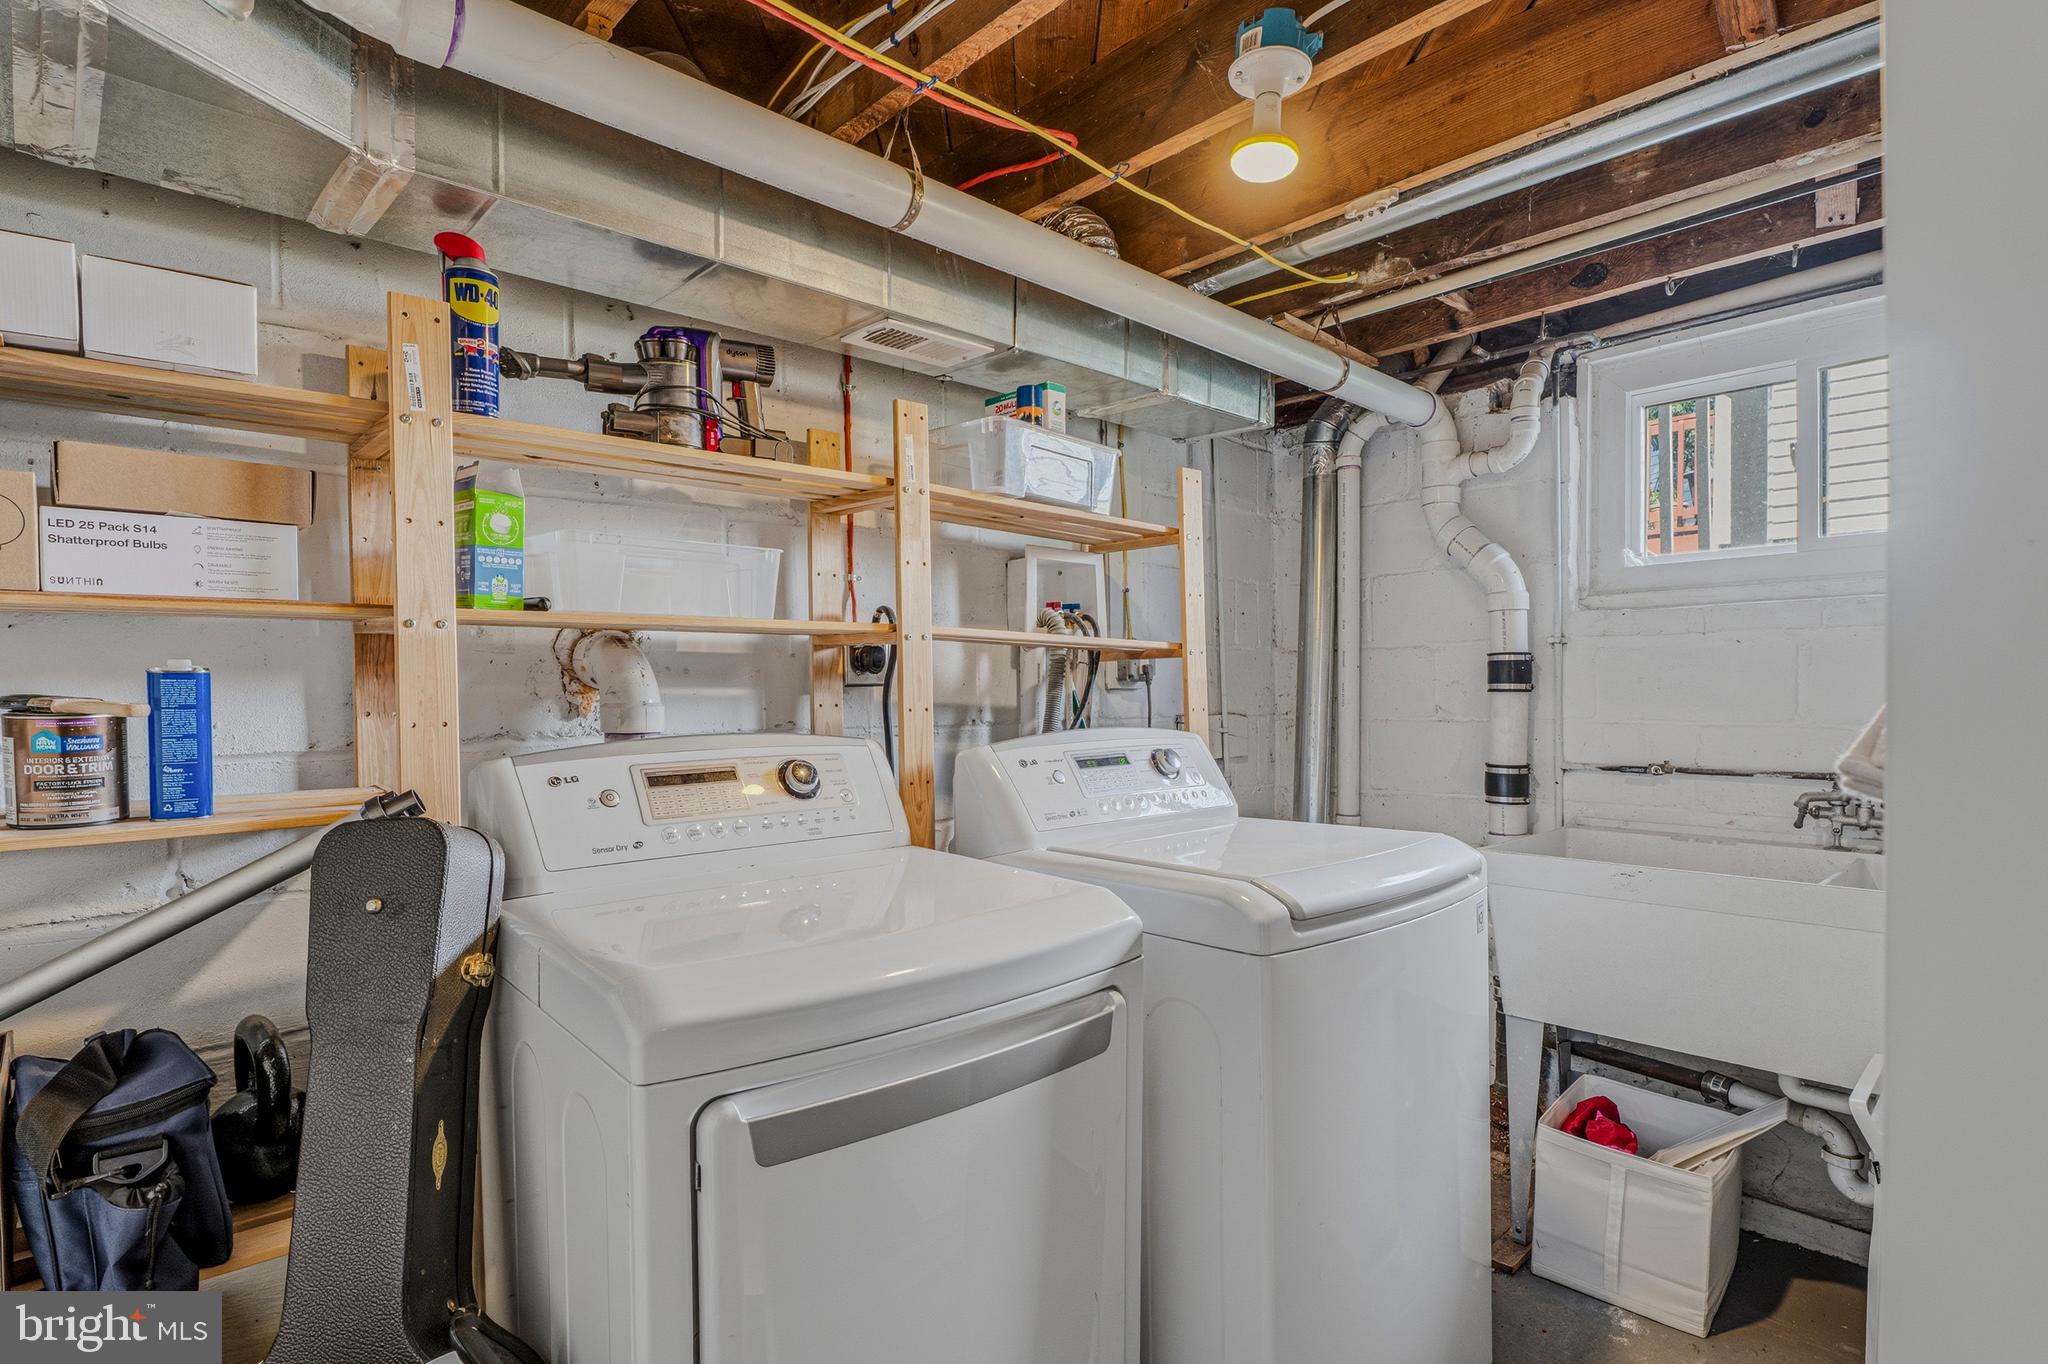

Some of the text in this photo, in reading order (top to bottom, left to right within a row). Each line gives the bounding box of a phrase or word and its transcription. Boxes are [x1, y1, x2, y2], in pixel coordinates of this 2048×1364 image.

[454, 282, 498, 309] WD-40
[726, 348, 748, 357] dyson
[1004, 400, 1016, 409] MUL
[47, 518, 157, 535] LED 25 Pack S14
[47, 534, 168, 550] Shatterproof Bulbs
[23, 761, 113, 775] DOOR & TRIM
[564, 775, 579, 784] LG
[592, 844, 628, 855] Sensor Dry
